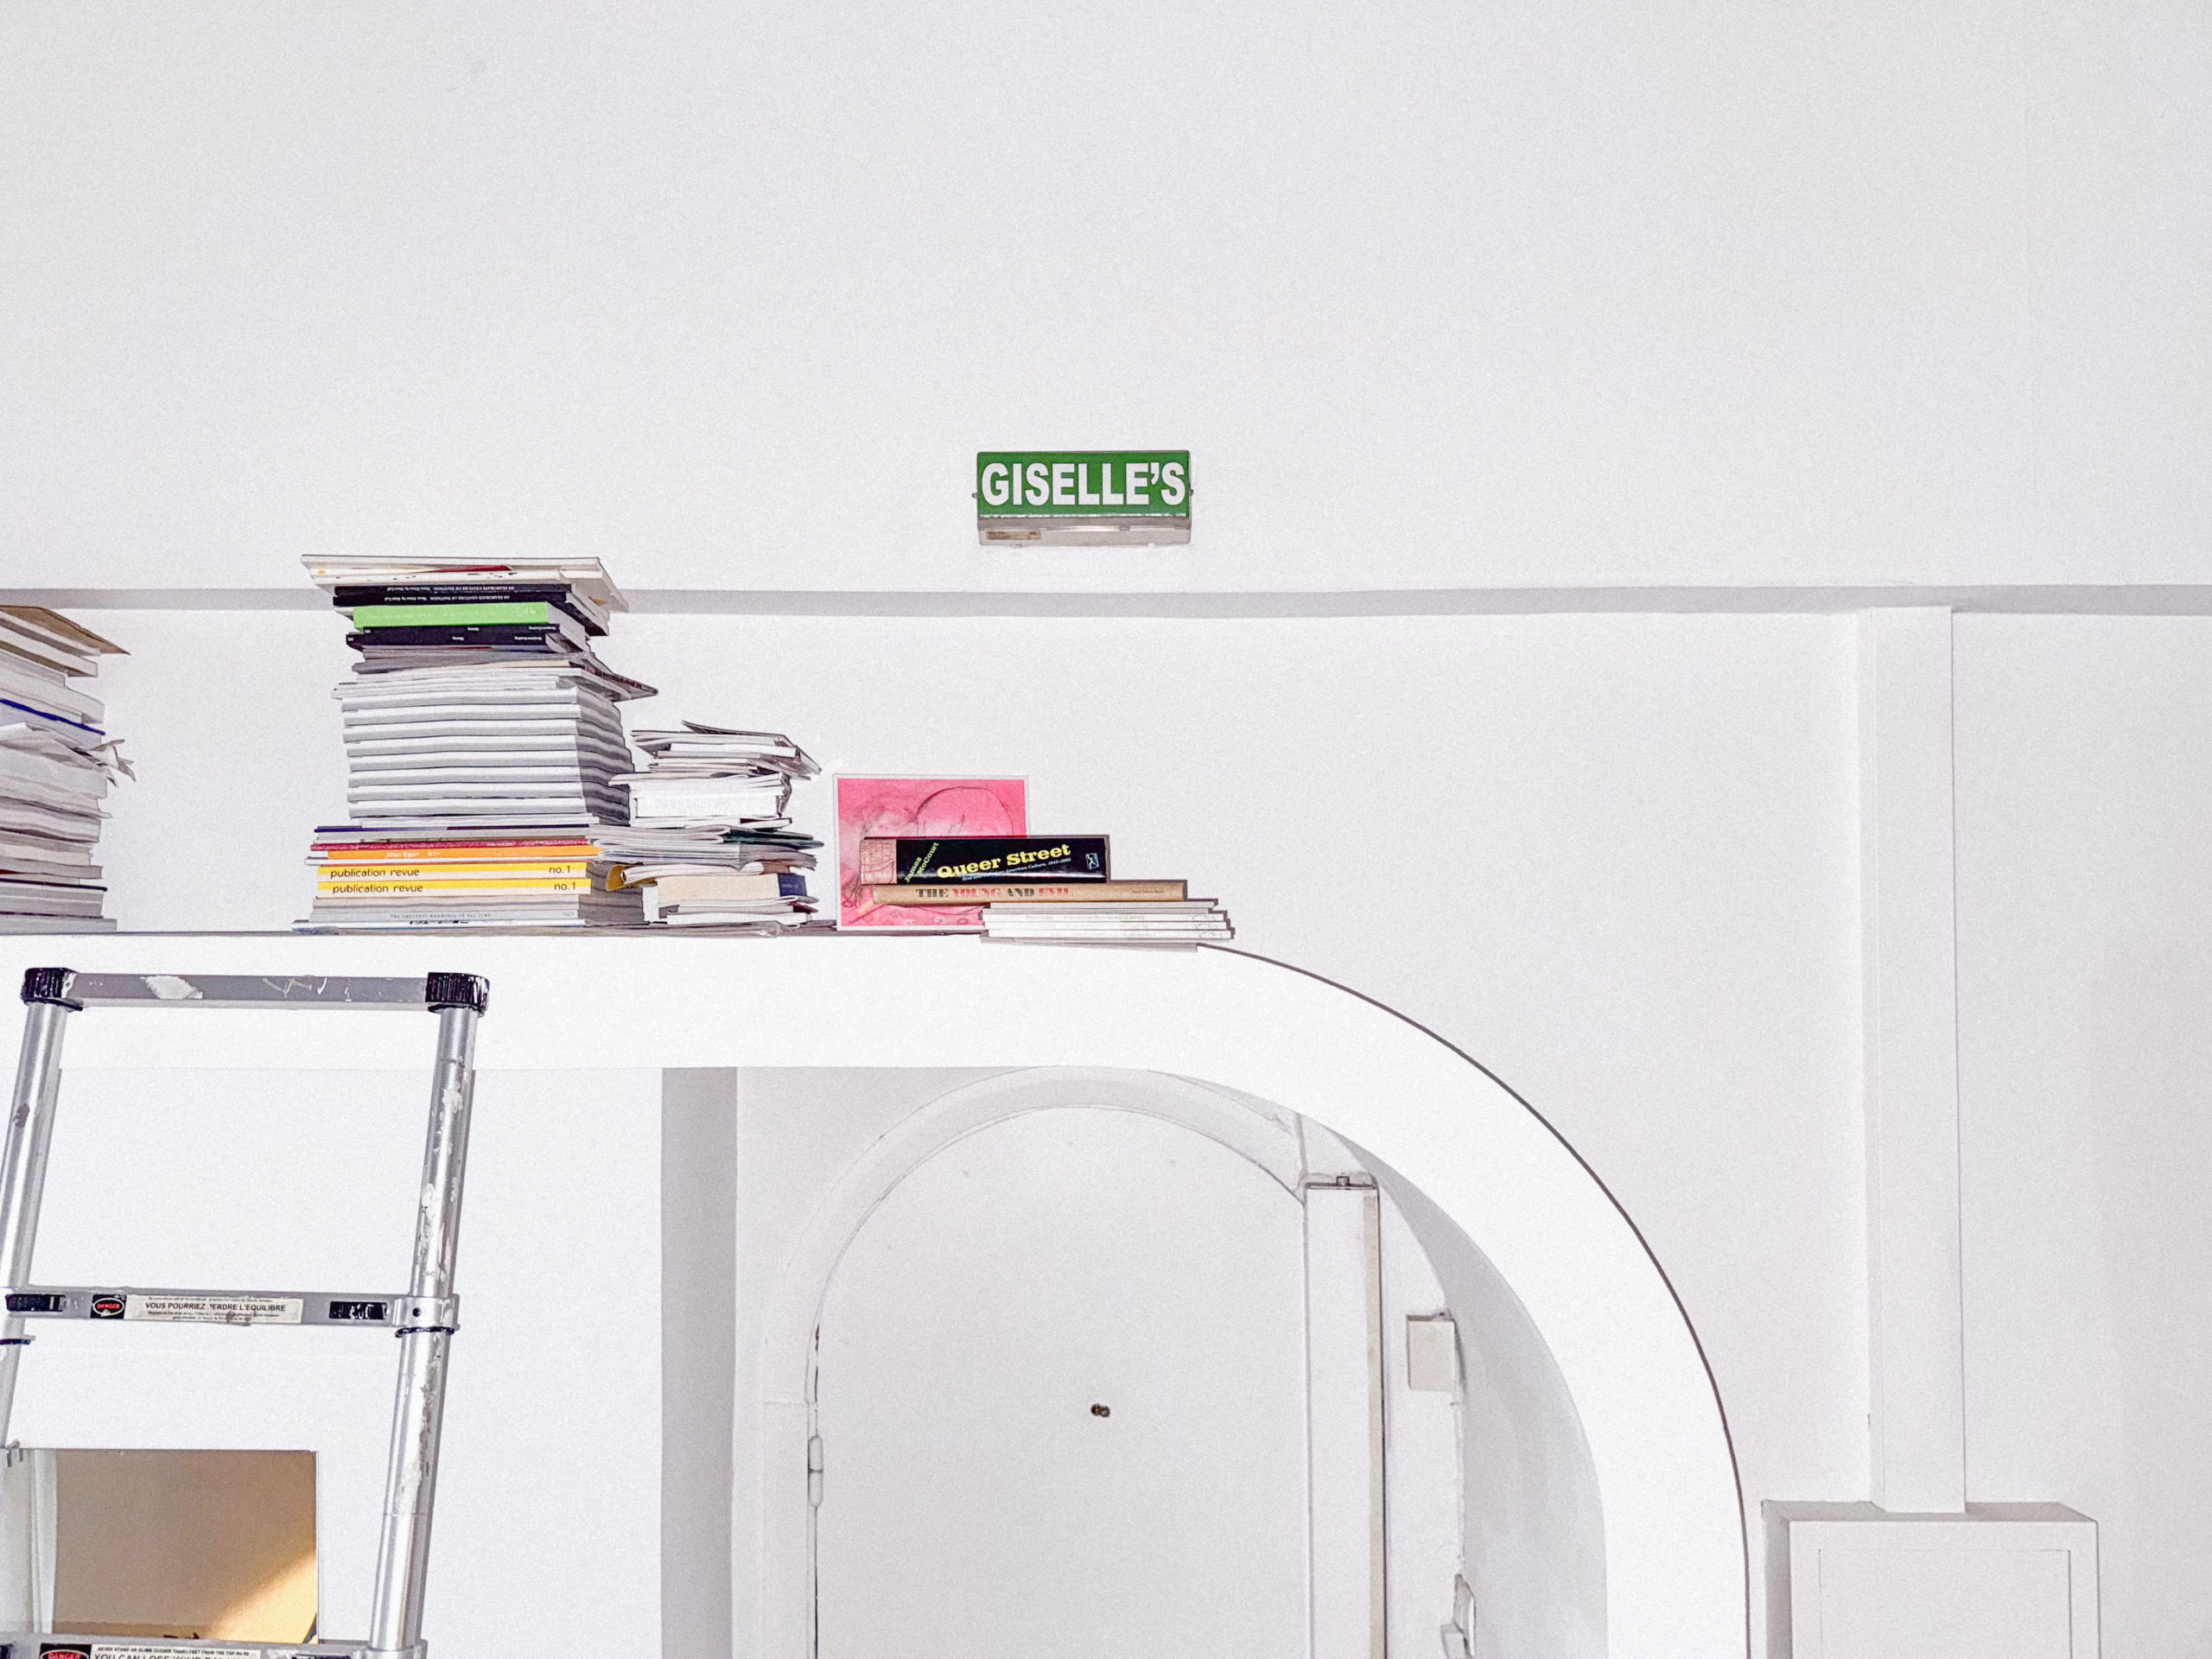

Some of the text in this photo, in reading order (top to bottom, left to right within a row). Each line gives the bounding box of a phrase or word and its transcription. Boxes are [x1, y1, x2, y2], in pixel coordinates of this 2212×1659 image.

[981, 461, 1186, 506] GISELLE'S
[904, 856, 923, 883] James
[937, 843, 1071, 879] Queer Street
[330, 868, 386, 880] publication
[332, 884, 423, 895] publication revue
[915, 887, 1073, 898] THE YOUNG AND EVIL
